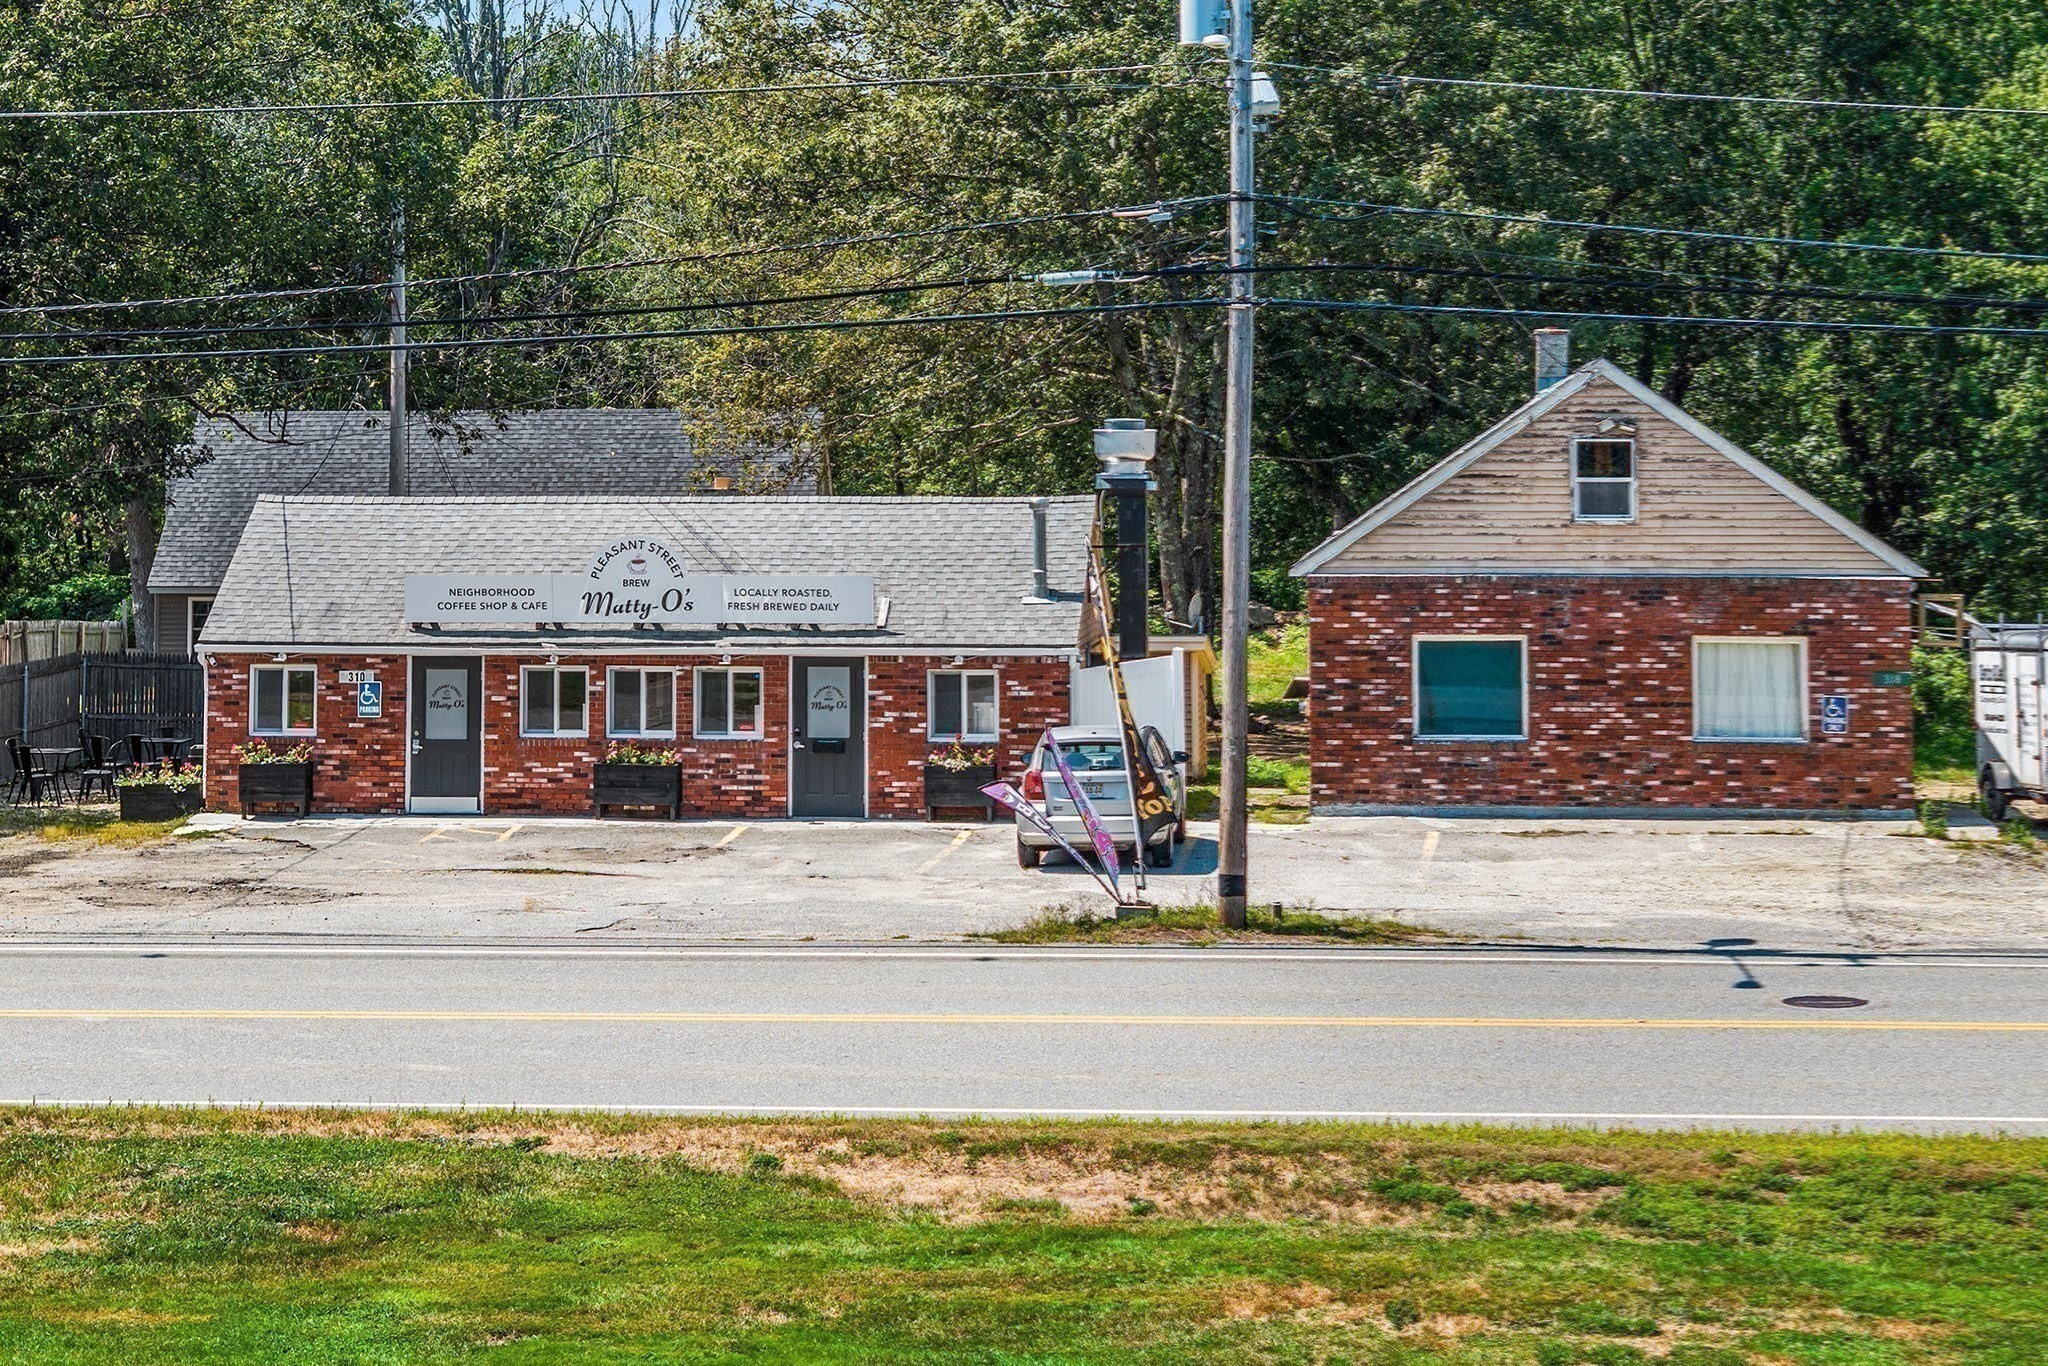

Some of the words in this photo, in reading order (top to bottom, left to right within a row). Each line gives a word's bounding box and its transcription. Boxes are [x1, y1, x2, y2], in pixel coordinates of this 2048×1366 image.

[590, 540, 645, 580] PLEASANT
[648, 542, 684, 579] STREET
[622, 579, 650, 587] BREW
[448, 588, 535, 597] NEIGHBORHOOD
[733, 588, 778, 597] LOCALLY
[782, 589, 832, 598] ROASTED,
[437, 601, 477, 610] COFFEE
[480, 601, 508, 610] SHOP
[511, 602, 518, 610] &
[520, 601, 547, 610] CAFE
[581, 588, 694, 620] Matty-O's
[727, 602, 760, 611] FRESH
[763, 602, 807, 611] BREWED
[810, 602, 839, 611] DAILY
[348, 672, 365, 682] 310
[359, 705, 379, 713] PARKING
